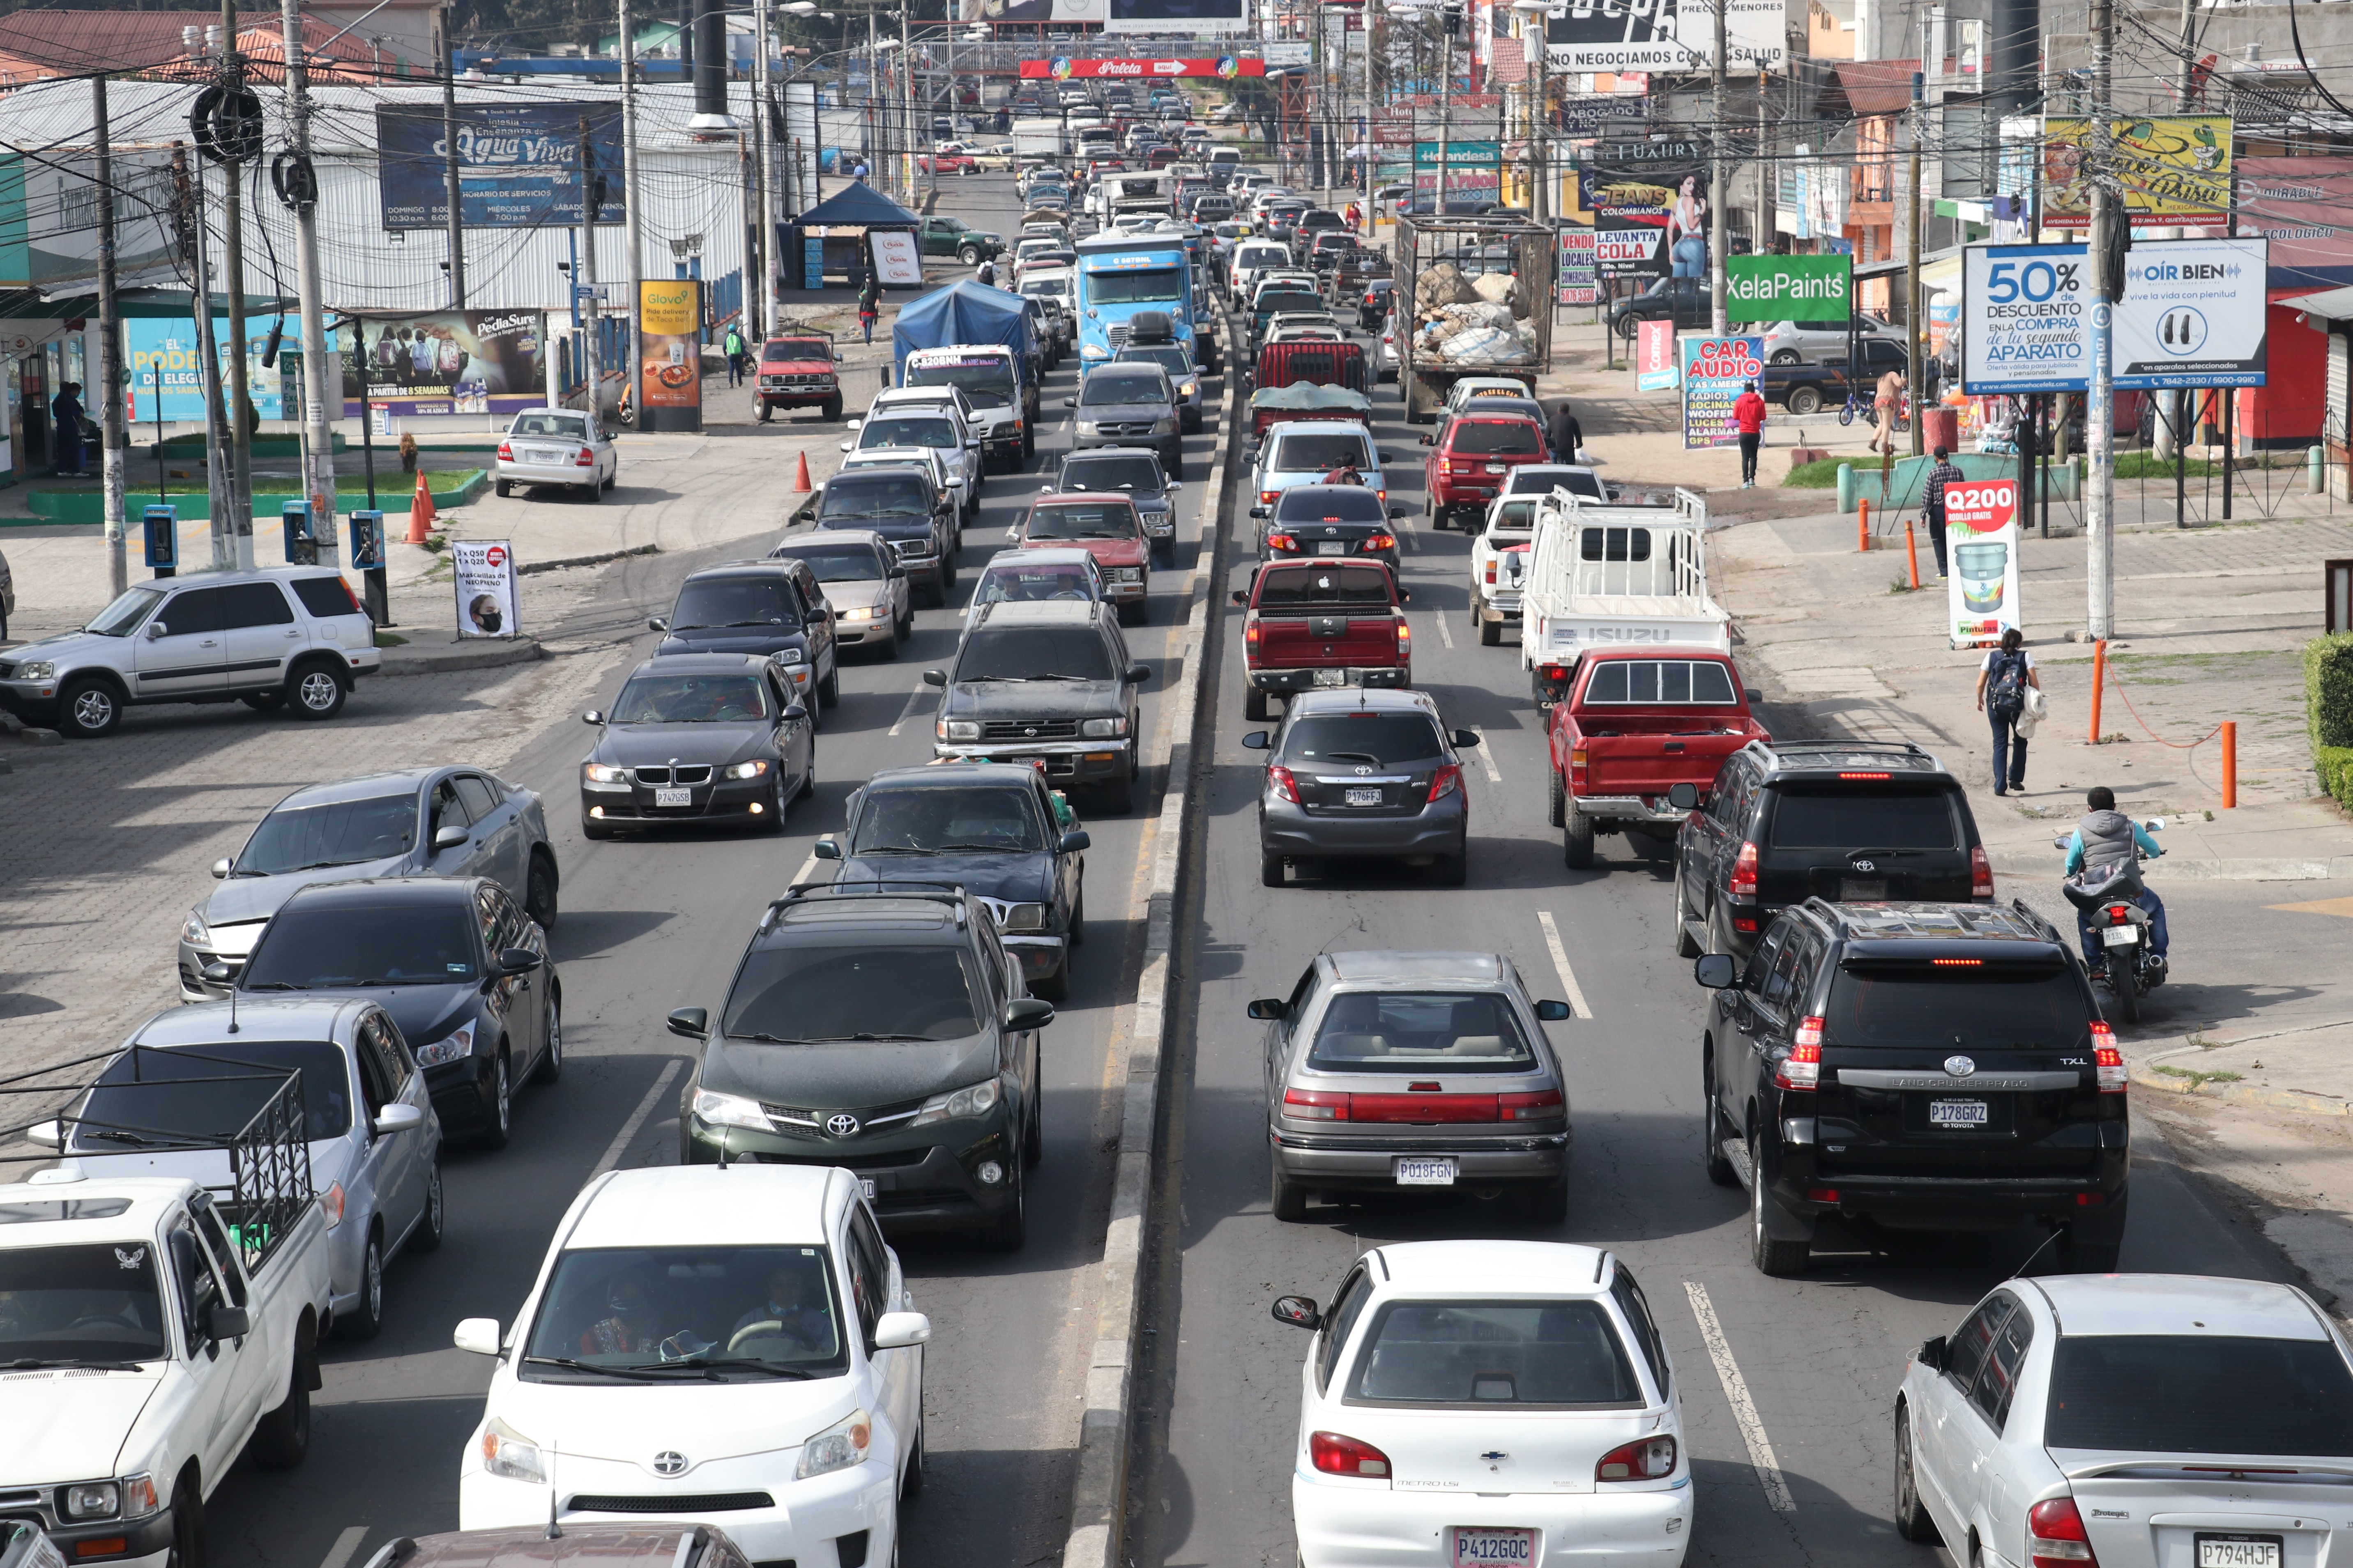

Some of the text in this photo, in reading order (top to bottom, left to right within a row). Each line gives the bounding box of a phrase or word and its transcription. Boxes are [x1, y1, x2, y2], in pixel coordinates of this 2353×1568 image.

[1731, 2, 1783, 11] MENORES
[1576, 51, 1671, 65] NEGOCIAMOS
[1735, 48, 1781, 61] SALUD
[1098, 61, 1142, 74] Paleta
[1157, 63, 1172, 71] aquí
[1568, 107, 1635, 119] ABOGADO
[433, 126, 575, 163] Agua Viva
[1421, 150, 1494, 161] Hoandesa
[1457, 175, 1498, 188] PISOS
[511, 190, 552, 198] SERVICIOS
[1600, 189, 1667, 205] JEANS
[2263, 186, 2324, 200] DURABLE
[487, 204, 531, 213] MIÉRCOLES
[1601, 207, 1663, 216] COLOMBIANOS
[1562, 234, 1595, 249] VENDO
[1596, 231, 1657, 243] LEVANTA
[1597, 243, 1645, 259] COLA
[1561, 252, 1595, 267] LOCALES
[2144, 260, 2224, 281] OÍR BIEN
[1561, 271, 1595, 285] COMERCIALES
[1987, 260, 2079, 303] 50%
[647, 291, 688, 304] Glovo
[1561, 288, 1594, 302] 5876 5330
[2061, 292, 2074, 301] de
[2130, 292, 2148, 300] vive
[2160, 291, 2180, 299] vida
[2199, 290, 2236, 300] plenitud
[1987, 302, 2082, 318] DESCUENTO
[477, 313, 536, 337] PediaSure
[2015, 317, 2080, 330] COMPRA
[479, 331, 498, 343] ayúdalo
[502, 329, 516, 337] llegar
[1987, 328, 2082, 349] de tu segundo
[165, 338, 180, 349] EL
[1649, 322, 1661, 370] Comex
[1699, 340, 1749, 359] CAR
[1986, 343, 2082, 361] APARATO
[912, 355, 961, 368] C-820BNH
[2047, 361, 2078, 370] jubilados
[2154, 363, 2186, 371] aparatos
[1686, 359, 1762, 379] AUDIO
[1641, 373, 1673, 385] Comex
[1710, 379, 1759, 389] AMERICAS
[373, 388, 398, 396] PARTIR
[398, 387, 408, 395] DE
[1982, 382, 2069, 390] www.oirbienmehacefeliz.com
[1689, 392, 1729, 400] RADIOS
[1689, 400, 1736, 409] BOCINAS
[1689, 419, 1724, 427] LUCES
[1688, 427, 1739, 437] ALARMAS
[1689, 437, 1711, 445] GPS
[1945, 487, 2012, 511] Q200
[1948, 511, 1992, 521] RODILLO GRATIS
[1588, 627, 1670, 643] ISUZU
[1960, 625, 1998, 633] Pinturas
[658, 793, 690, 802] P747GSB
[1347, 791, 1381, 801] P176FFJ
[1892, 1078, 2029, 1088] LAND CRUISER PRADO
[1932, 1106, 1985, 1121] P178GRZ
[1401, 1163, 1451, 1178] P018FGN
[1397, 1479, 1440, 1487] METRO
[1459, 1538, 1529, 1559] P412GQC
[2203, 1544, 2276, 1565] P794HJF
